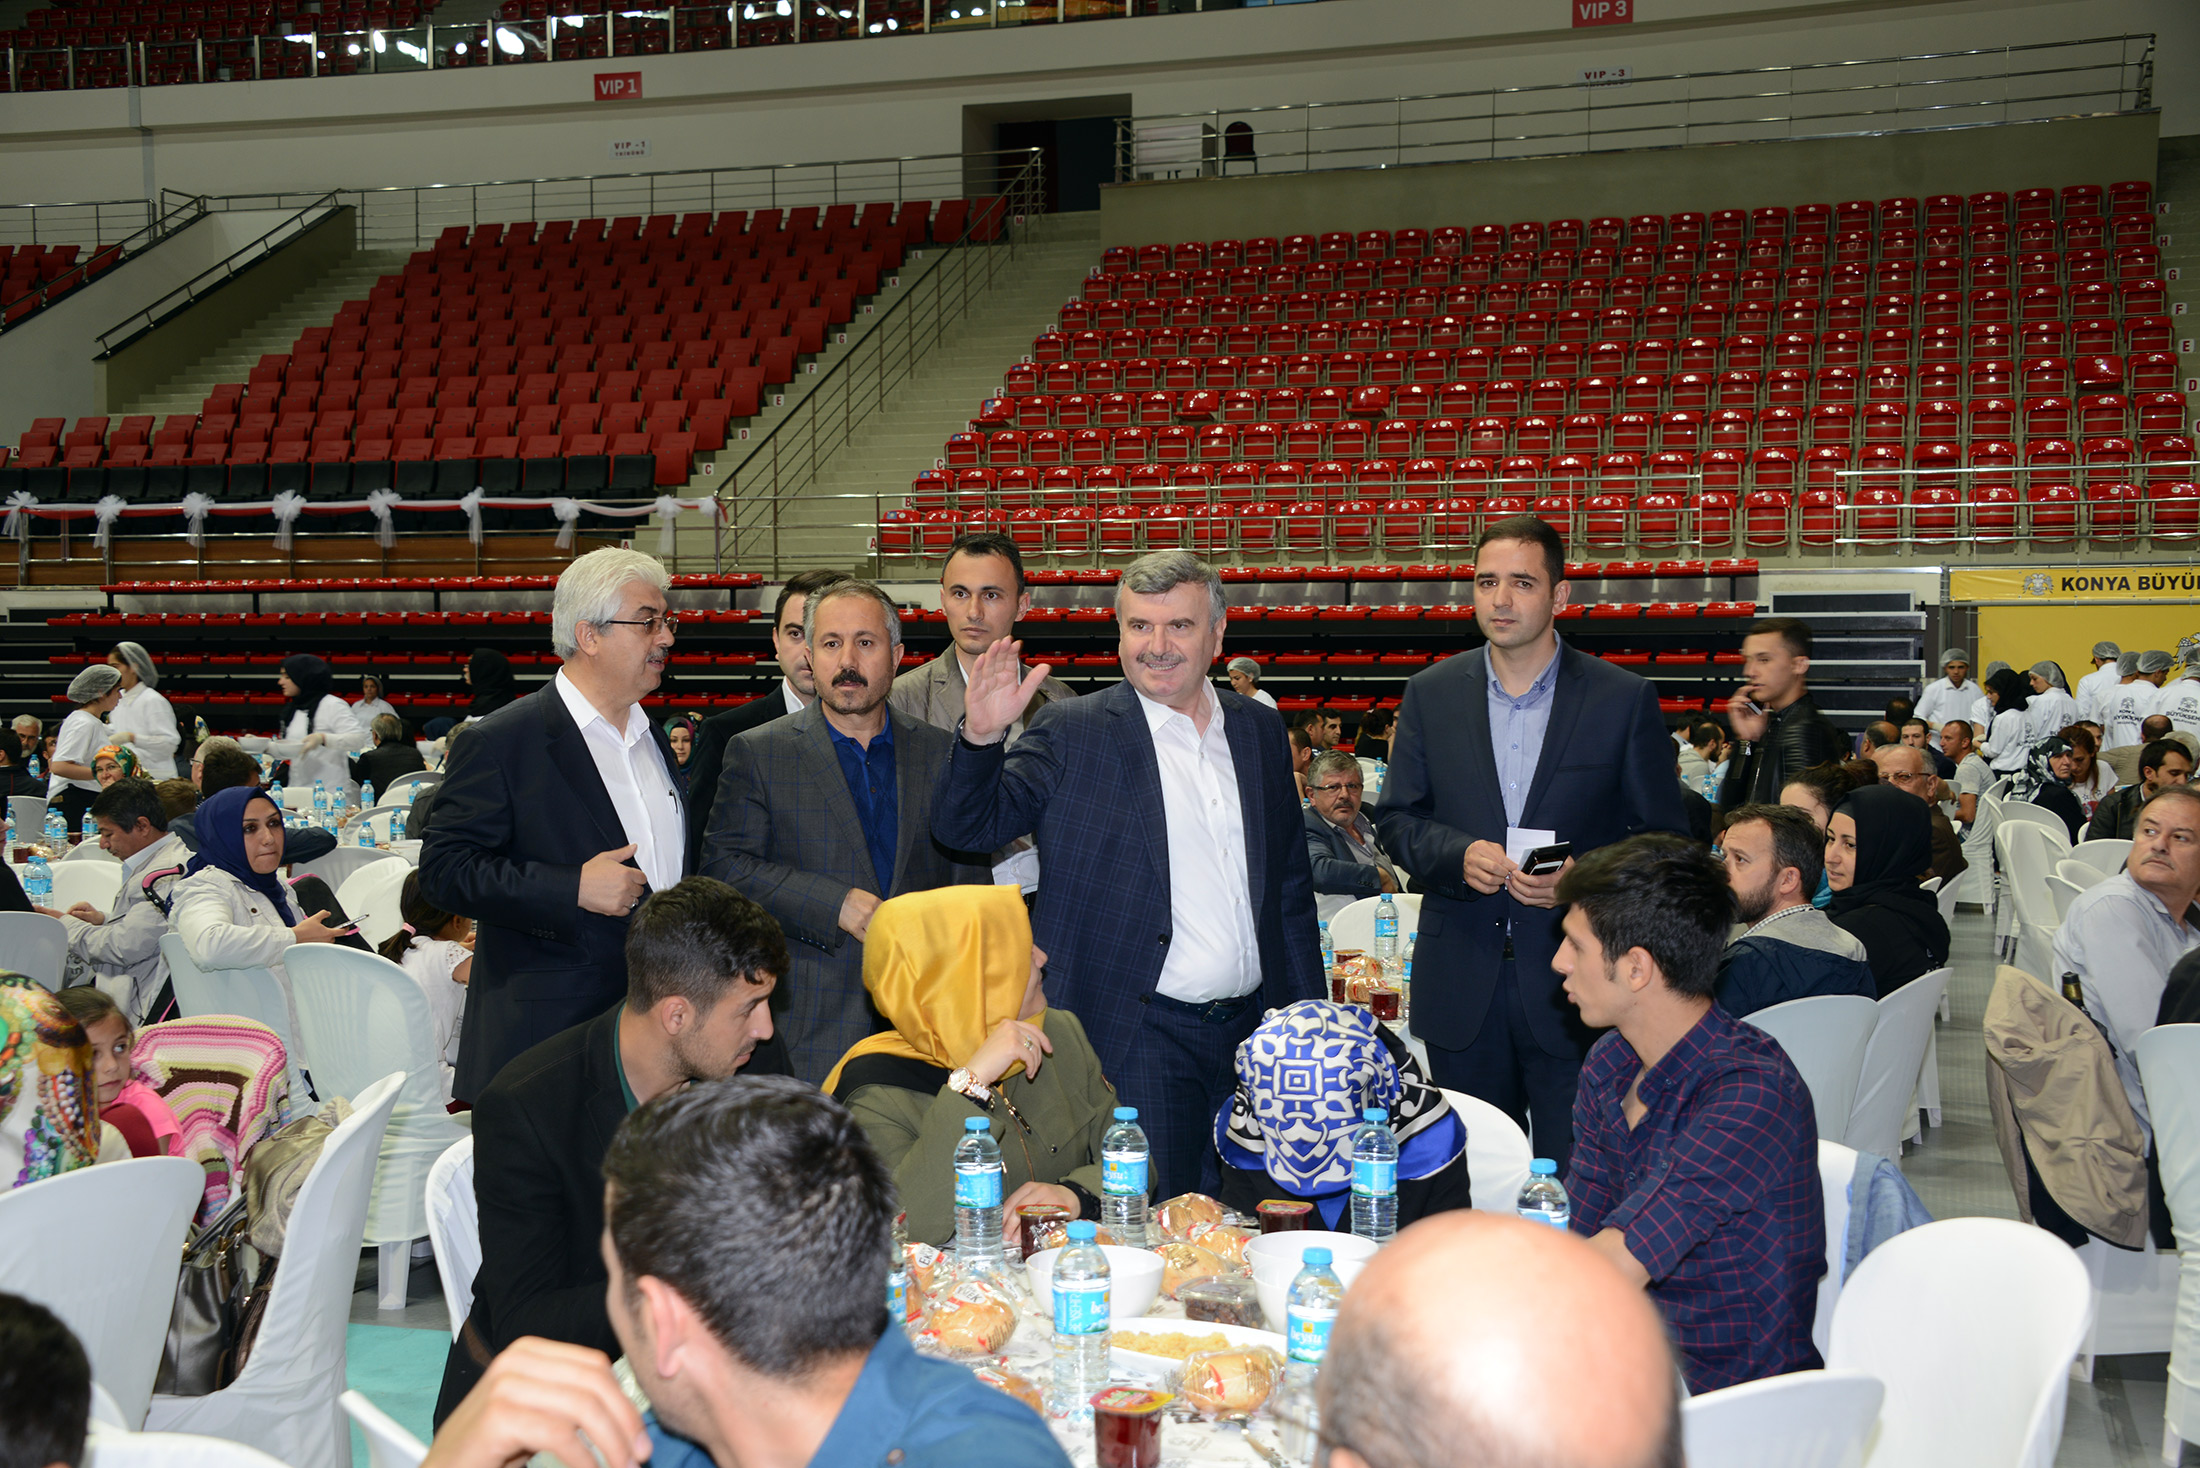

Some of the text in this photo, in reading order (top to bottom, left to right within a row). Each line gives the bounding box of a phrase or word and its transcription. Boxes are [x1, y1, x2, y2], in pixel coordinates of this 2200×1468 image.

[1579, 0, 1627, 20] VIP 3
[1584, 70, 1606, 80] VIP
[599, 78, 637, 95] VIP 1
[614, 142, 631, 150] VIP
[2158, 203, 2167, 214] K
[2160, 235, 2169, 247] H
[2168, 269, 2177, 280] G
[866, 306, 872, 315] H
[2175, 304, 2183, 315] F
[838, 334, 846, 344] G
[2182, 340, 2190, 352] E
[809, 363, 815, 374] F
[2188, 379, 2197, 392] D
[776, 396, 782, 406] E
[741, 430, 748, 440] D
[937, 458, 943, 469] C
[705, 465, 712, 475] C
[905, 496, 912, 507] B
[623, 541, 630, 550] A
[870, 537, 877, 549] A
[2061, 575, 2131, 591] KONYA
